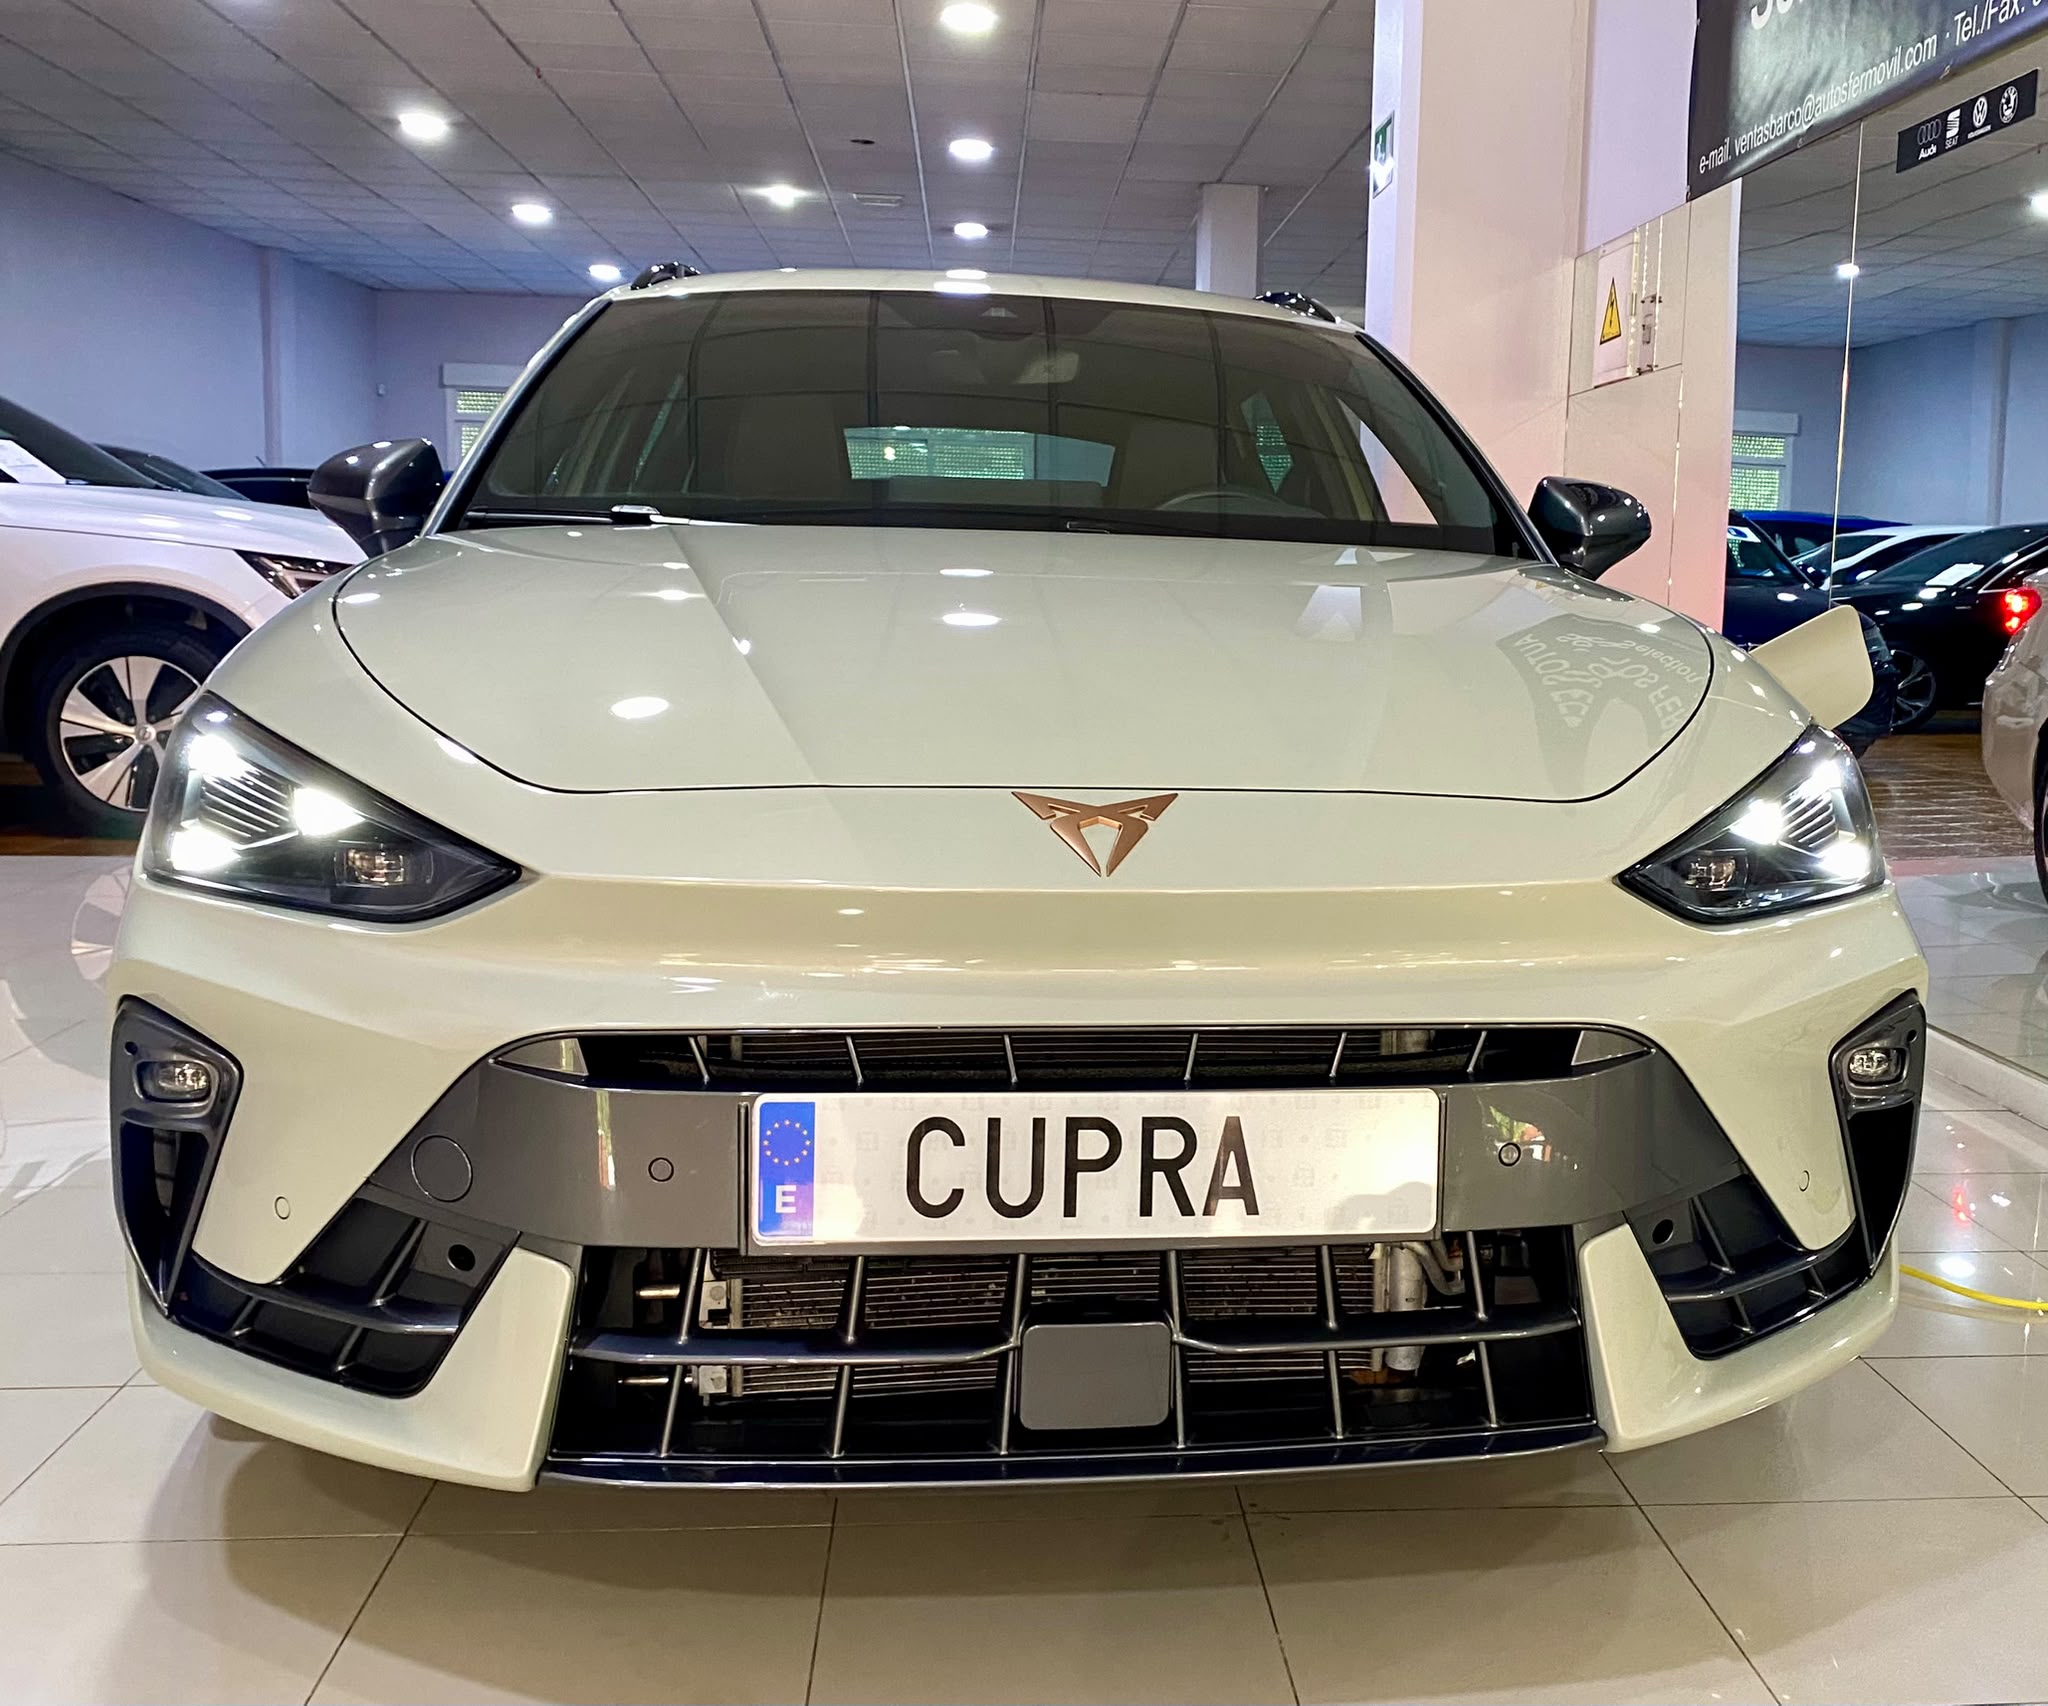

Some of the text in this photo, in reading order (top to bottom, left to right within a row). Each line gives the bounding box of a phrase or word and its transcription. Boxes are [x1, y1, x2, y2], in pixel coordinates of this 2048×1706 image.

[1699, 0, 2025, 174] e-mail. ventasbarco@autosfermovil.com Tel./Fax.
[1918, 143, 1938, 160] Audi
[1945, 135, 1959, 149] SEAT
[905, 1115, 1260, 1220] CUPRA
[775, 1184, 798, 1214] E
